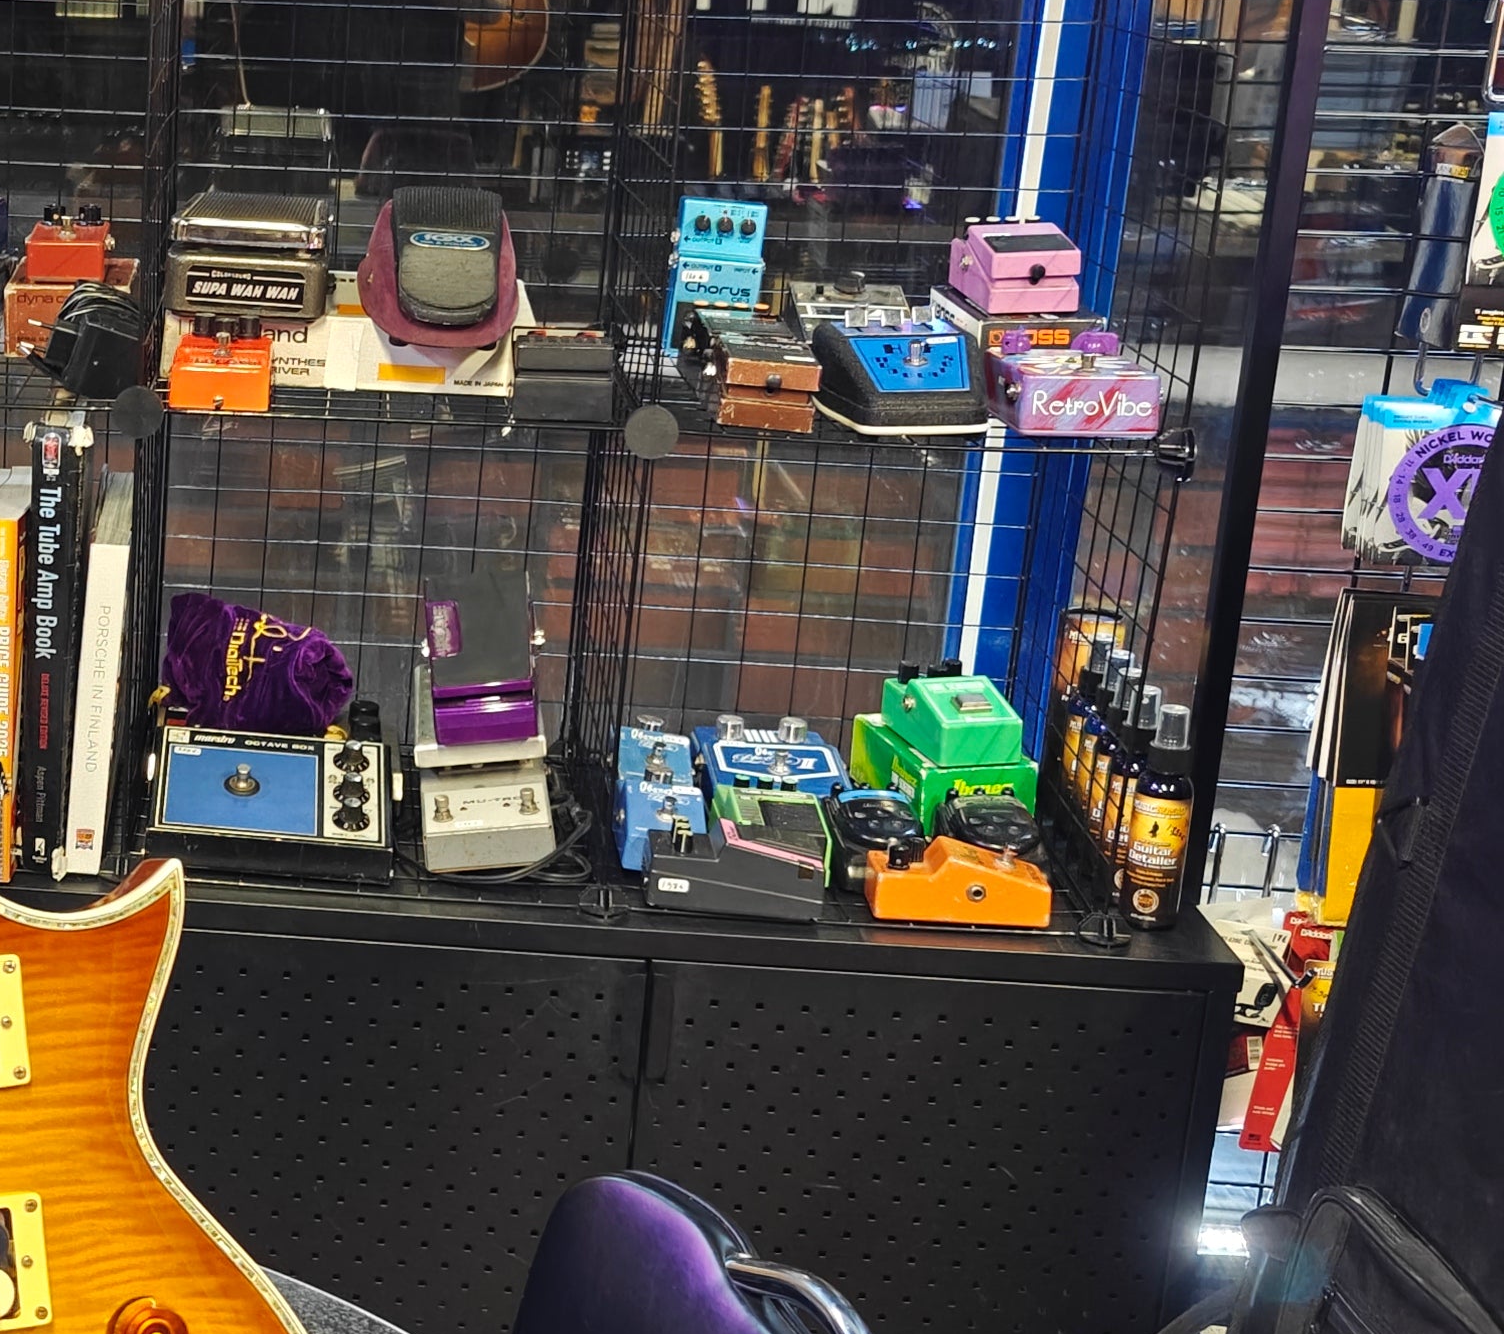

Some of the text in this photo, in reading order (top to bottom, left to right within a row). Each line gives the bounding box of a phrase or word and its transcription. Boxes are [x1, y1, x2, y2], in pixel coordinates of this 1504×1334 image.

[192, 281, 299, 300] SUPA WAH WAH
[684, 281, 751, 297] Chorus
[17, 293, 53, 305] dyna
[1006, 329, 1070, 346] OSS
[272, 367, 310, 376] RIVER
[1032, 390, 1152, 417] RetroVibe
[1415, 432, 1465, 458] NICKEL
[31, 487, 62, 660] The Tube Amp Book
[85, 605, 111, 773] PORSCHE IN FINLAND
[244, 739, 288, 749] OCTAVE
[35, 766, 47, 791] Aspen
[1133, 841, 1174, 857] Guitar
[1129, 850, 1178, 866] Detailer
